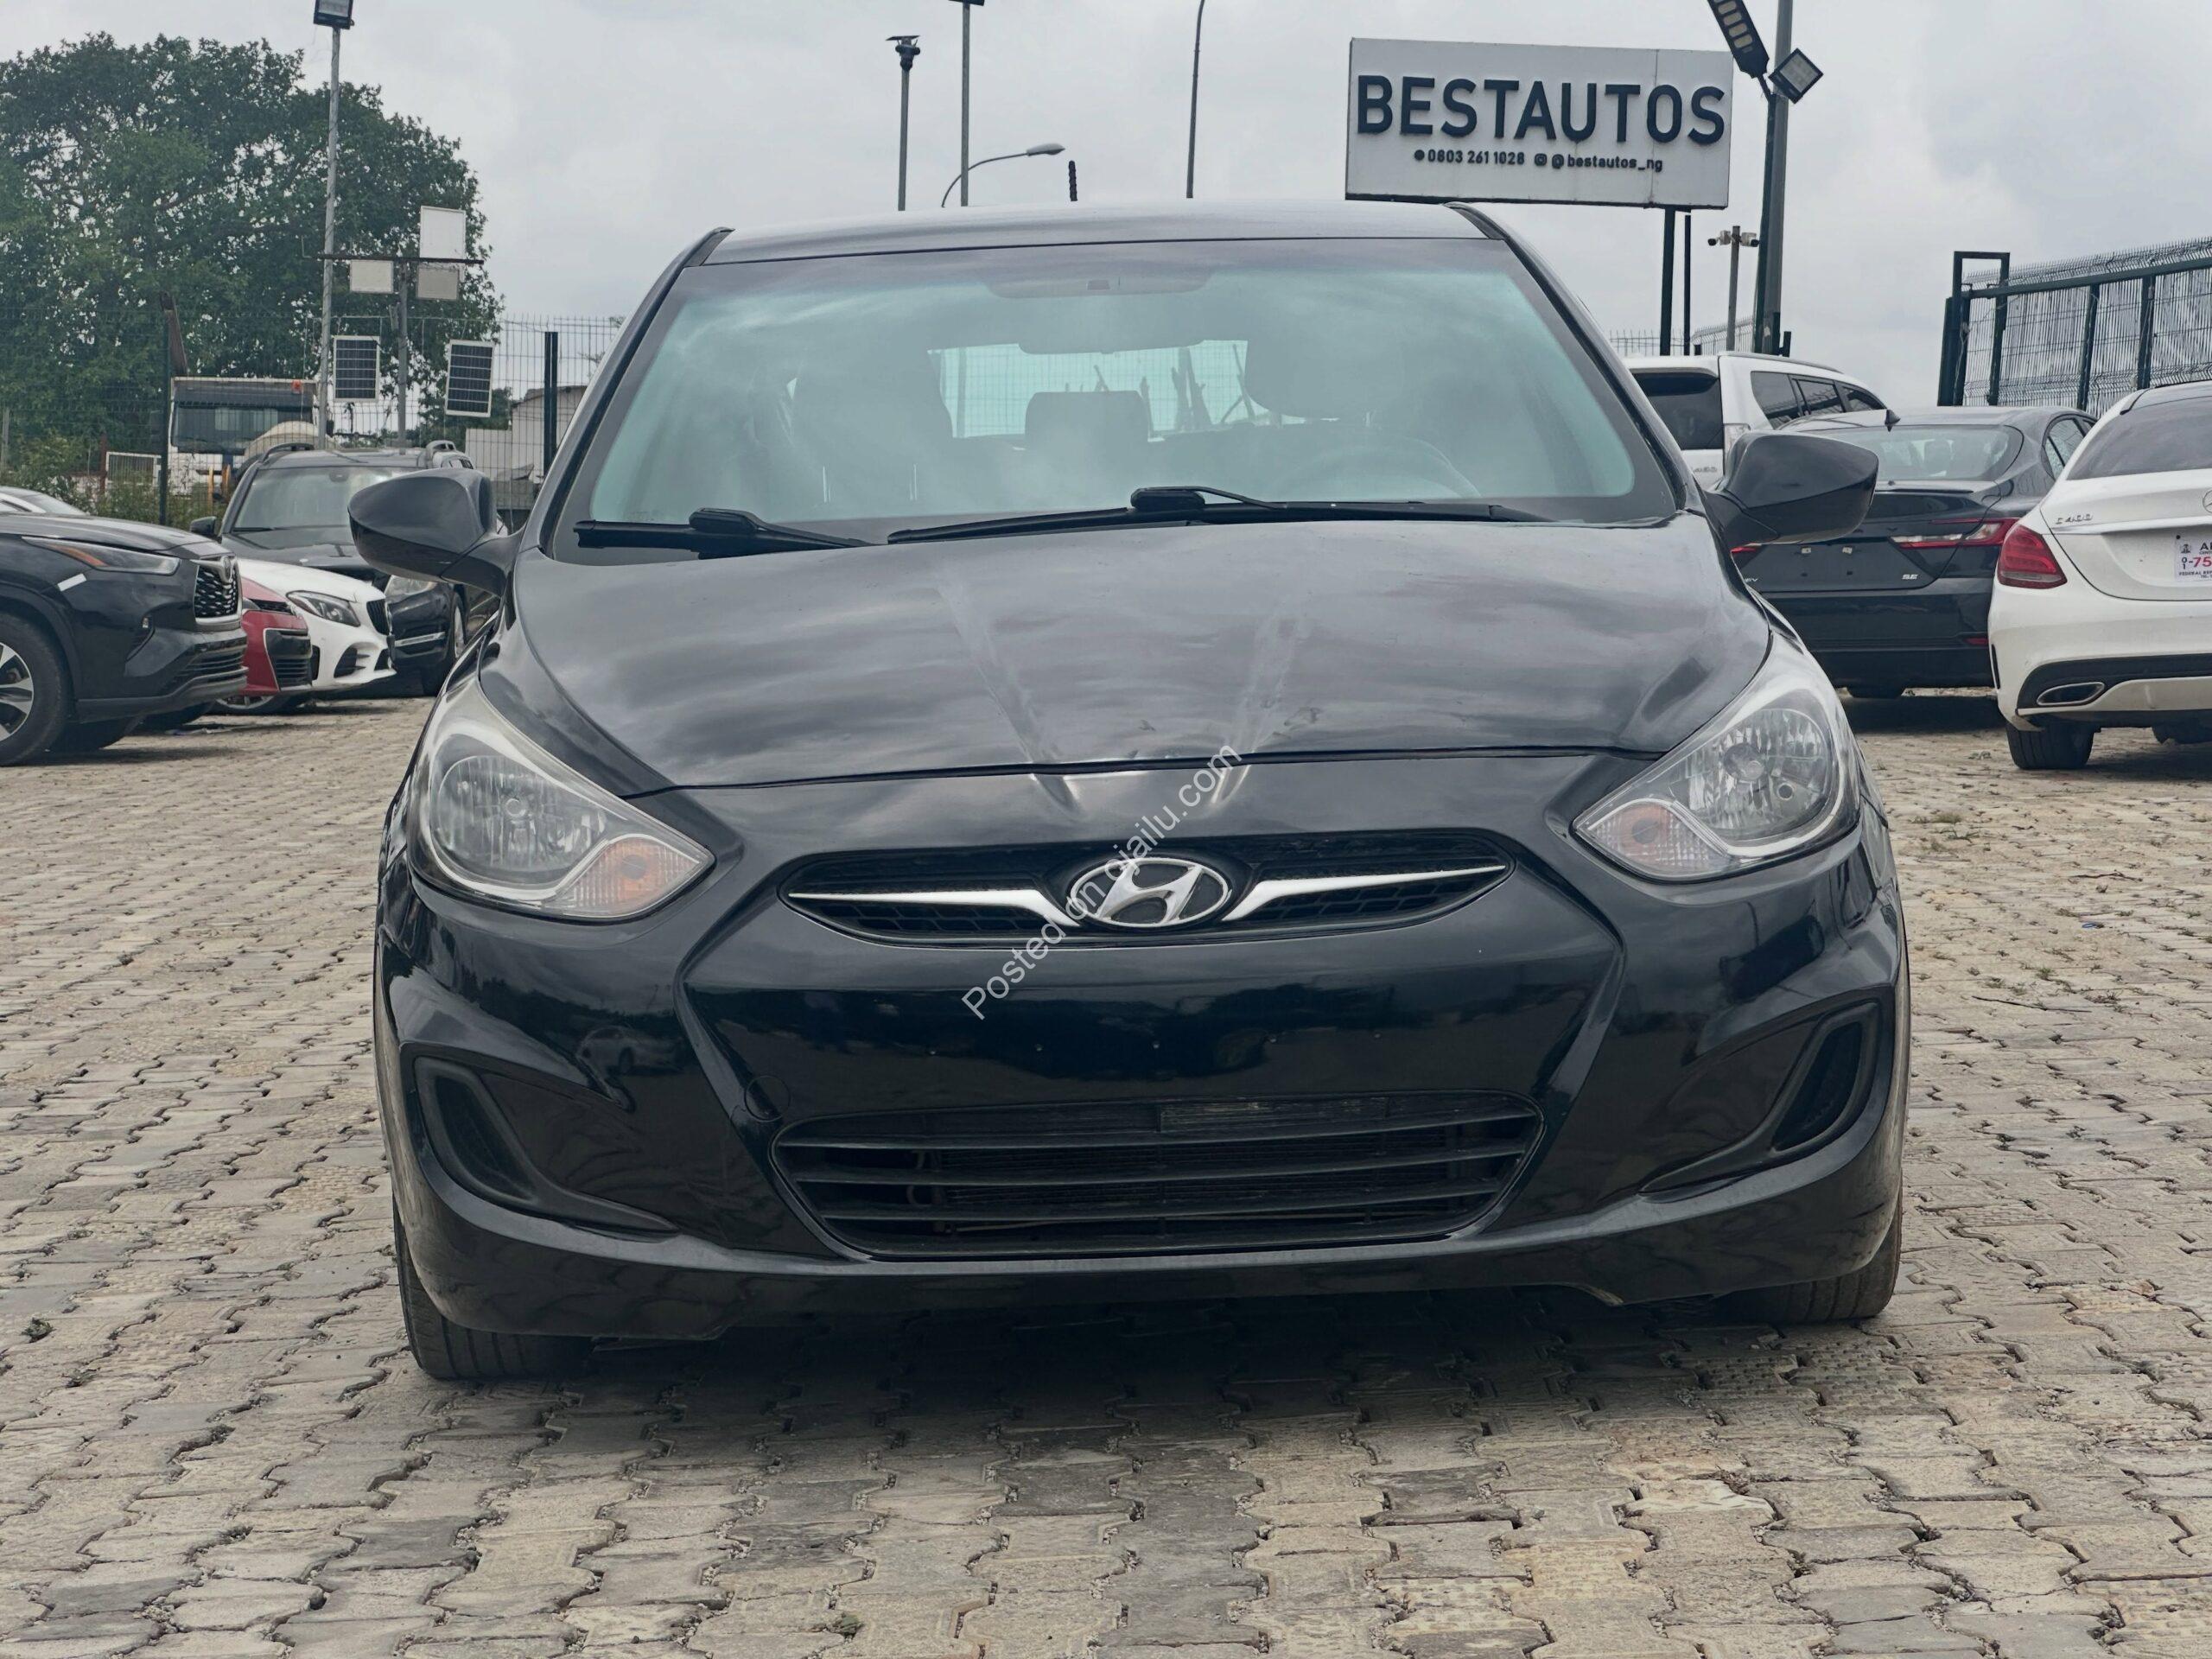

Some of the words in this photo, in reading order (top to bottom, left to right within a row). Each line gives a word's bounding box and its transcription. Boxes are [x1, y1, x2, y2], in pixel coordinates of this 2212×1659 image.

[1357, 74, 1726, 145] BESTAUTOS
[1427, 149, 1464, 163] 0803
[1467, 149, 1489, 164] 261
[1493, 151, 1525, 165] 1028
